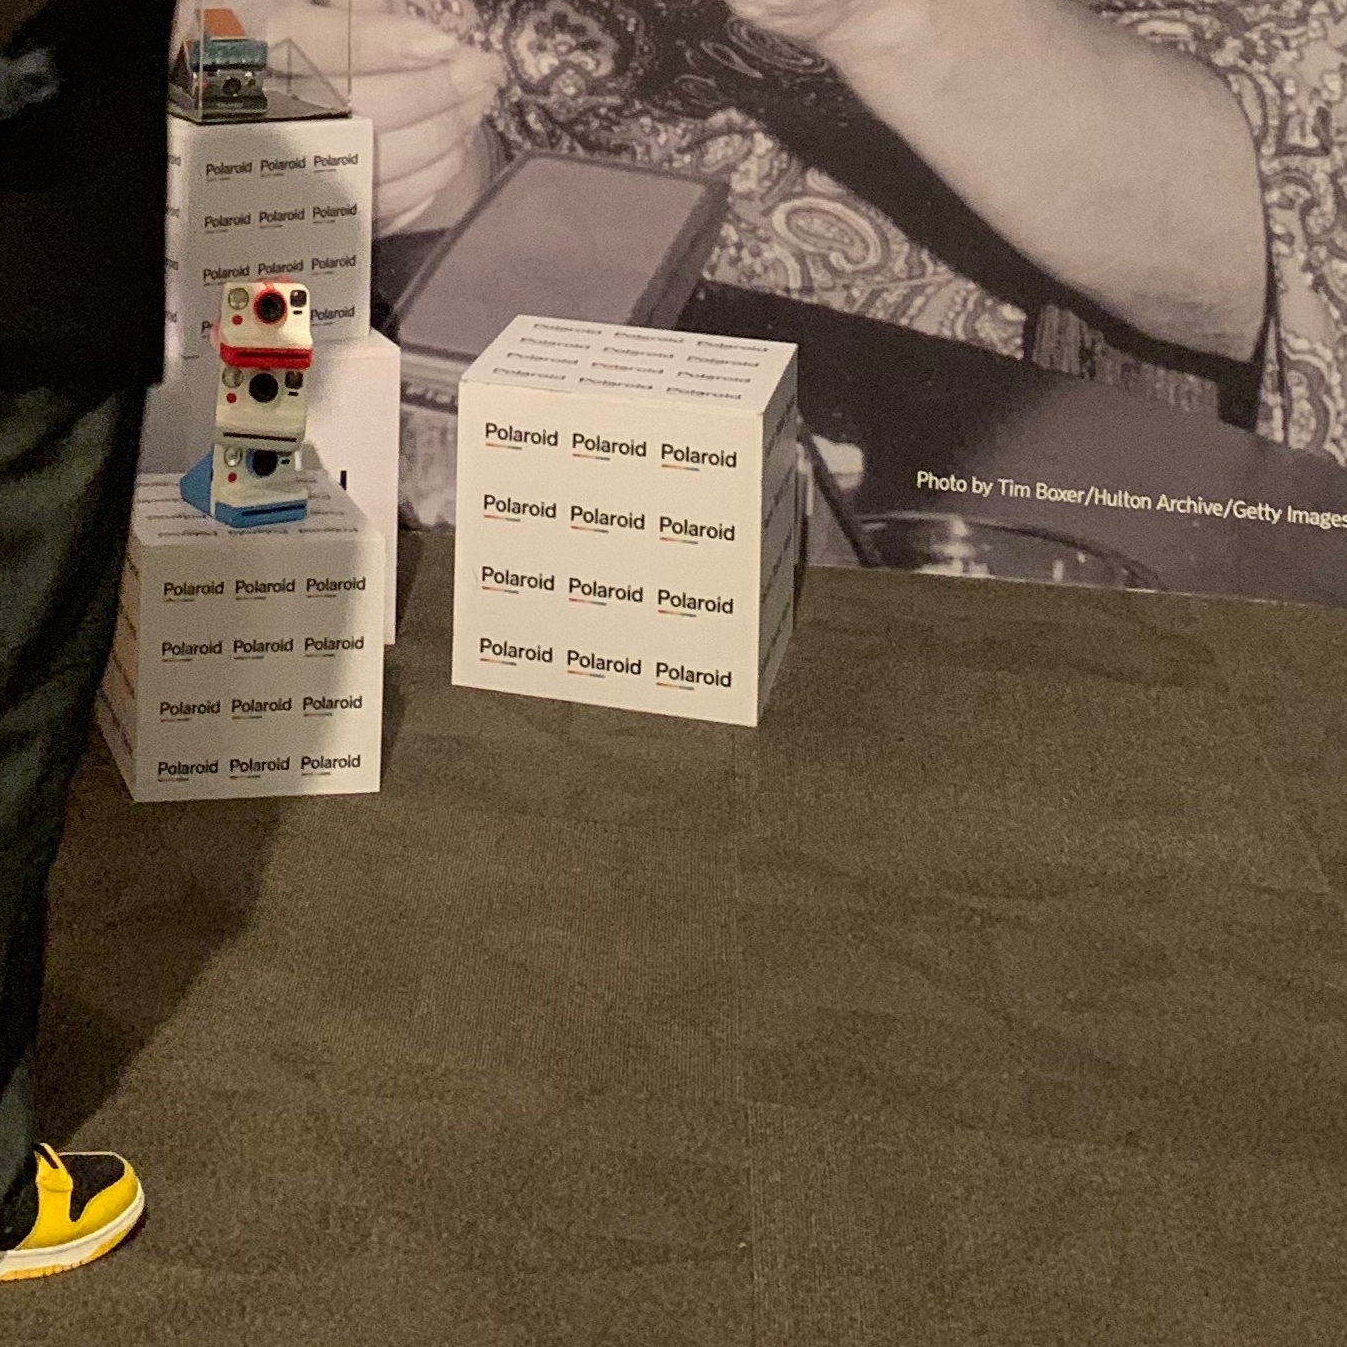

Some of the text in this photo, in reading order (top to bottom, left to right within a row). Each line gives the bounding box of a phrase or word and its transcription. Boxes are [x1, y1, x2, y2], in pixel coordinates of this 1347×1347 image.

[206, 154, 358, 175] Polaroid Polaroid Polaroid
[205, 204, 357, 228] Polaroid Polaroid Polaroid
[204, 255, 356, 281] Polaroid Polaroid Polaroid
[485, 422, 737, 468] Polaroid Polaroid Polaroid
[916, 470, 1347, 530] Photo by Tim Boxer/Hulton Archive/Getty Images
[483, 494, 735, 542] Polaroid Polaroid Polaroid
[164, 577, 366, 596] Polaroid Polaroid Polaroid
[482, 566, 734, 615] Polaroid Polaroid Polaroid
[162, 637, 364, 655] Polaroid Polaroid Polaroid
[480, 638, 732, 688] Polaroid Polaroid Polaroid
[160, 696, 362, 715] Polaroid Polaroid Polaroid
[158, 755, 360, 775] Polaroid Polaroid Polaroid
